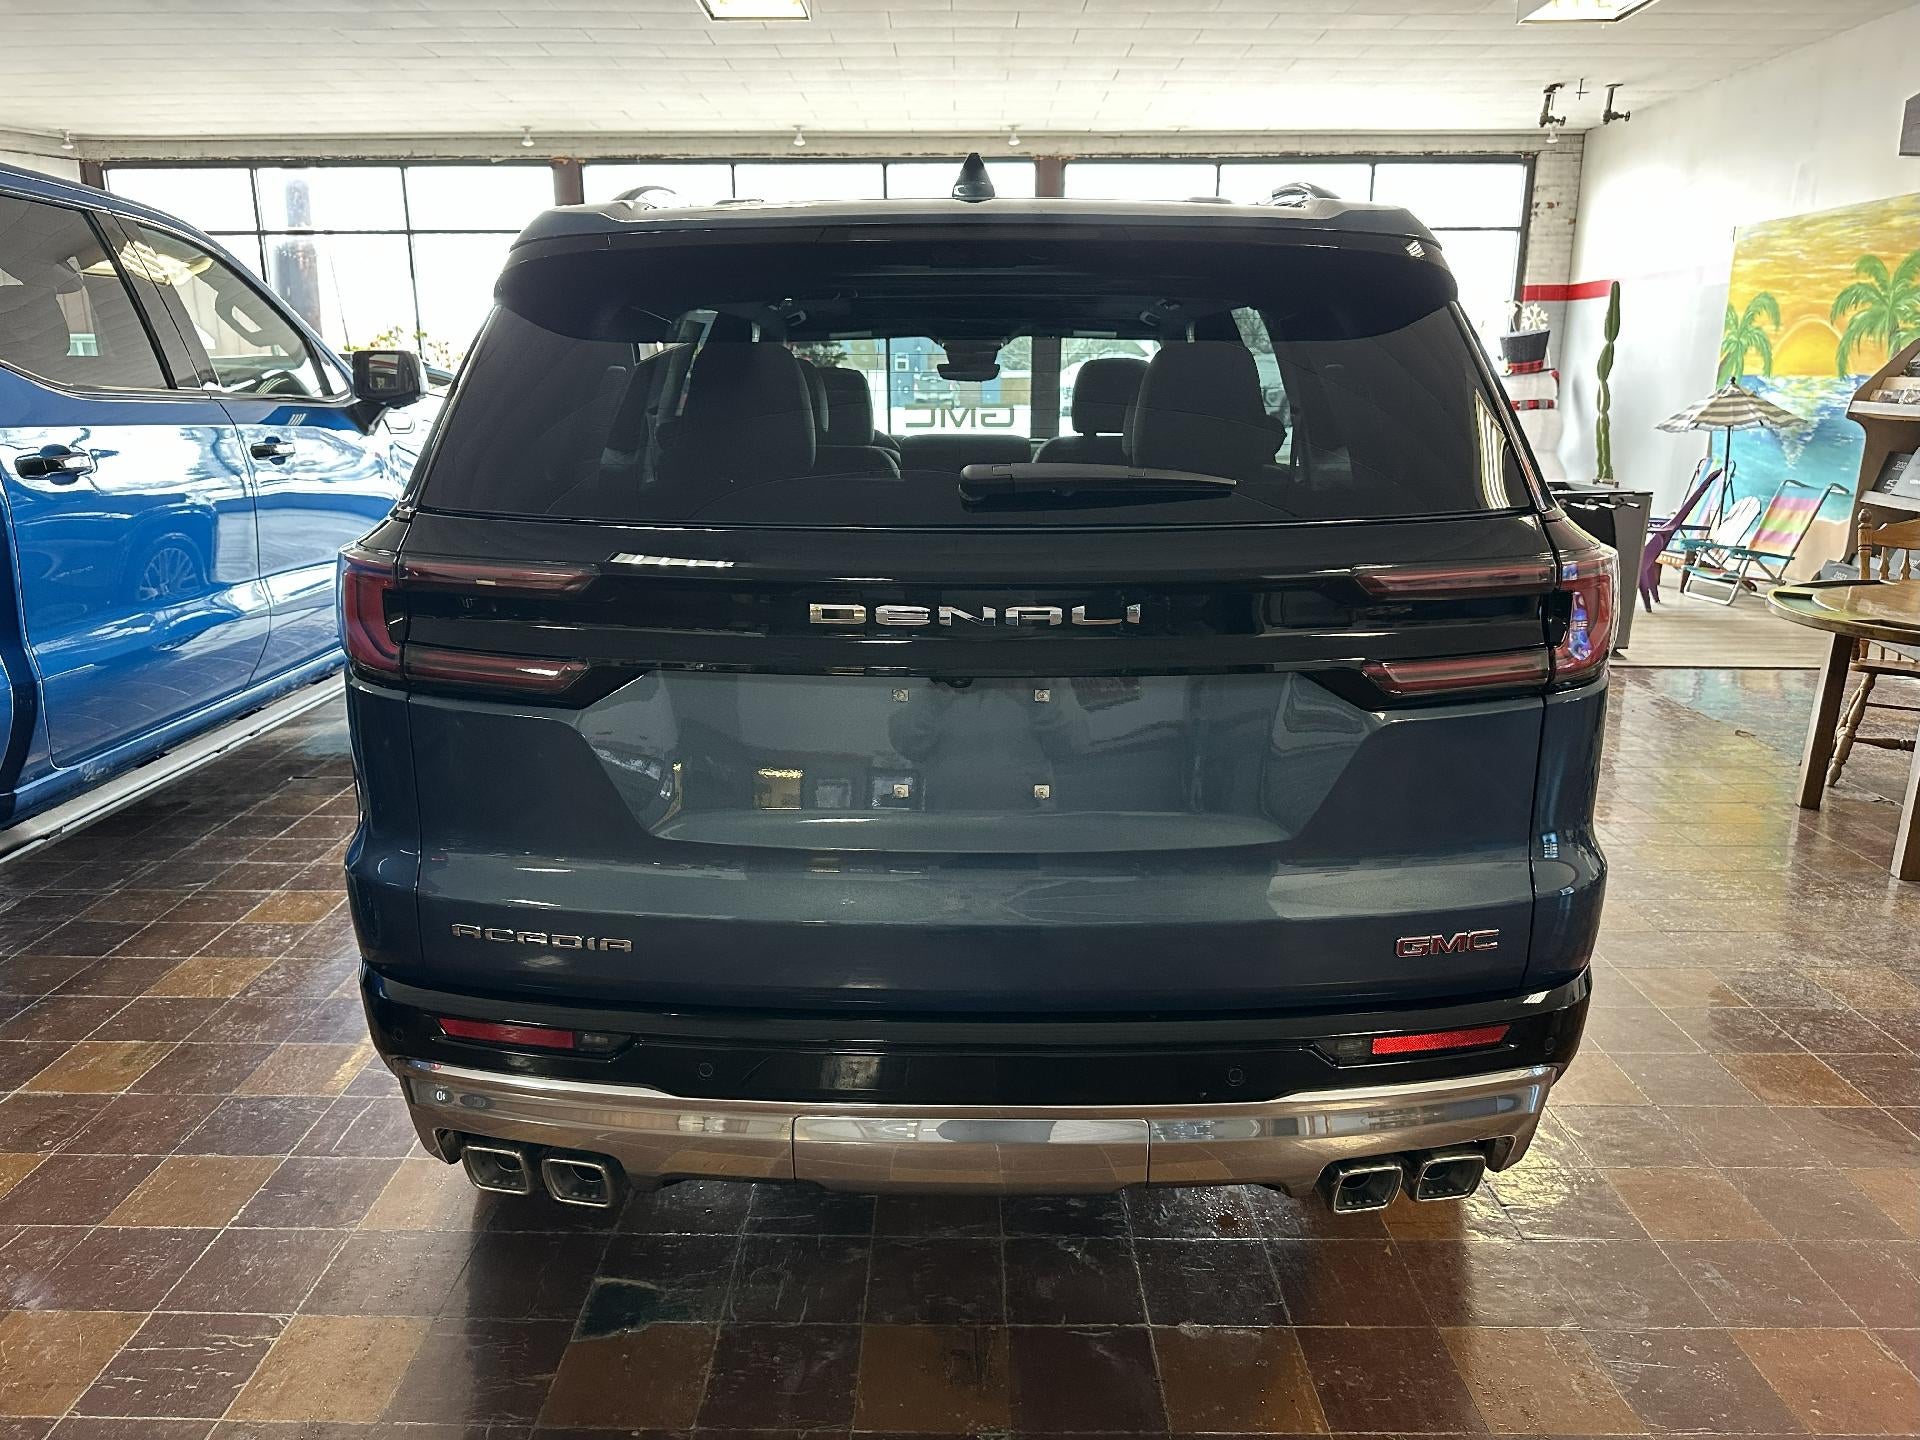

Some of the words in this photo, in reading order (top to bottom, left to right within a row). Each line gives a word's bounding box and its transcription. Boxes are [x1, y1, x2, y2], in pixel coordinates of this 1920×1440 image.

[809, 603, 1142, 627] DENALI
[451, 923, 632, 952] ACADIA
[1395, 928, 1500, 958] GMC
